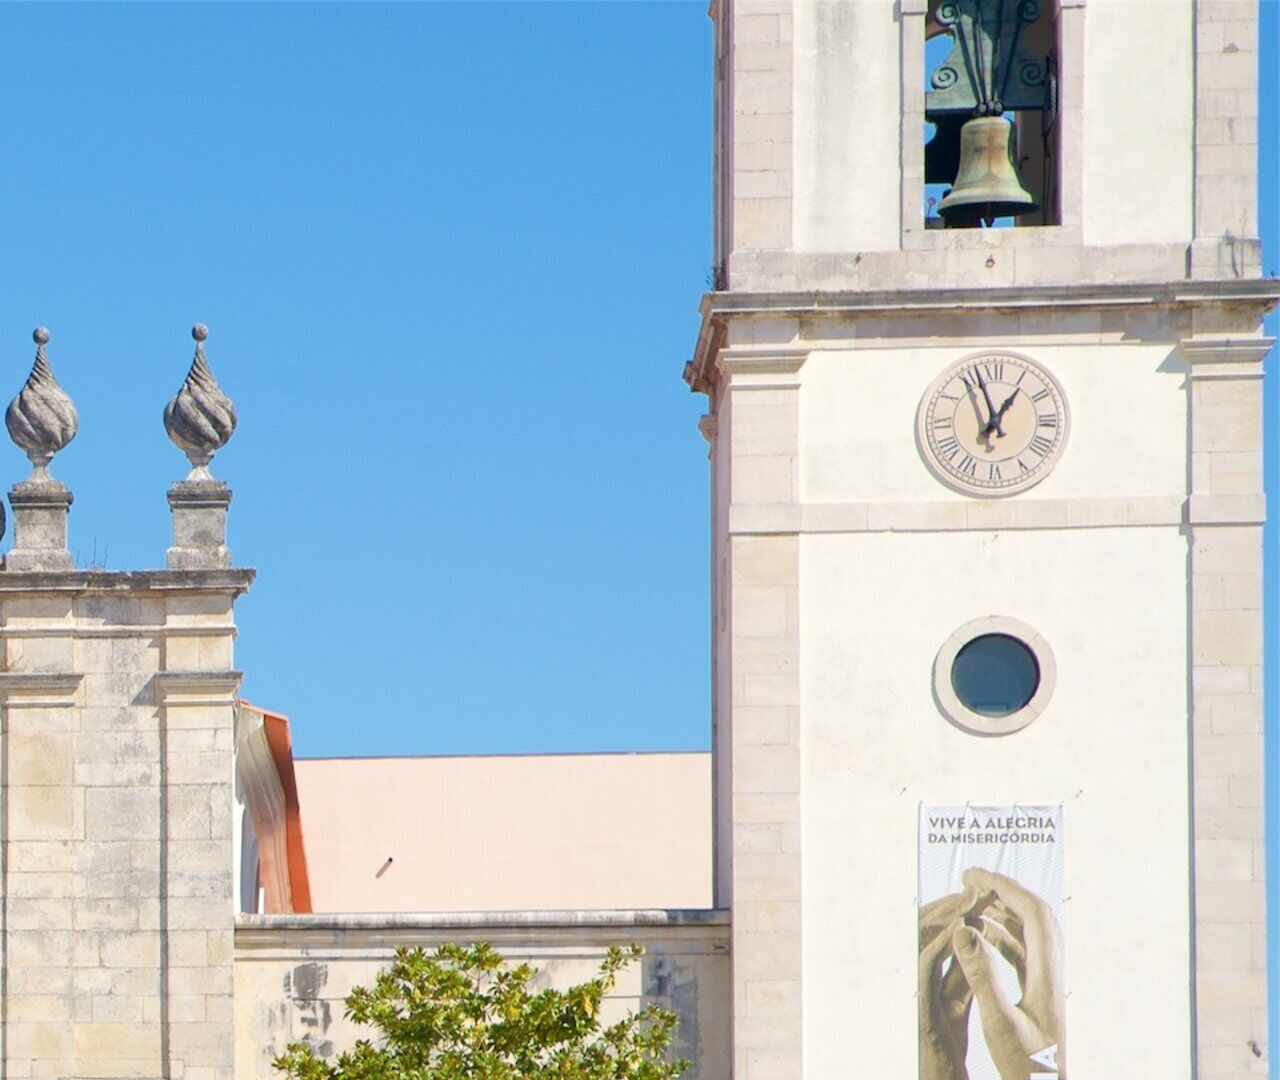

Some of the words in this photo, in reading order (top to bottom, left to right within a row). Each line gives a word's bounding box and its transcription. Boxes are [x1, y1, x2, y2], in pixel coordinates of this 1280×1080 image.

[1031, 388, 1050, 403] II
[1038, 413, 1057, 428] III
[929, 817, 966, 829] VIVE
[970, 817, 981, 829] A
[985, 817, 1056, 829] ALEGRIA
[928, 833, 947, 844] DA
[951, 831, 1056, 844] MISERICÓRDIA
